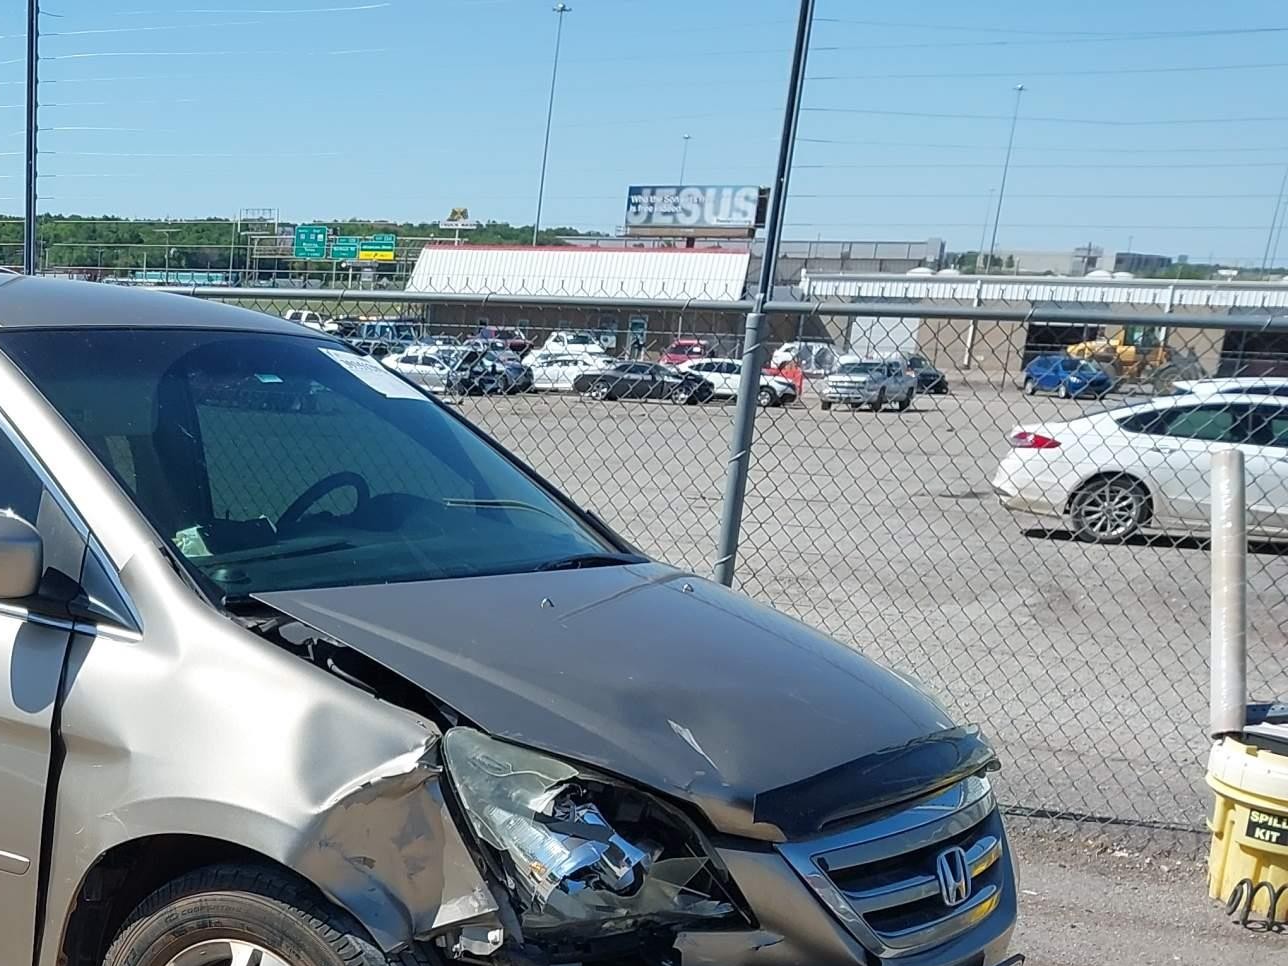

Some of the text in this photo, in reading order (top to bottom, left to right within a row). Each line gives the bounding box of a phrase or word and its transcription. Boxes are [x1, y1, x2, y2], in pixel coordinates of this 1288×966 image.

[626, 186, 758, 226] JESUS
[1250, 810, 1288, 829] SPILL
[1254, 826, 1280, 842] KIT
